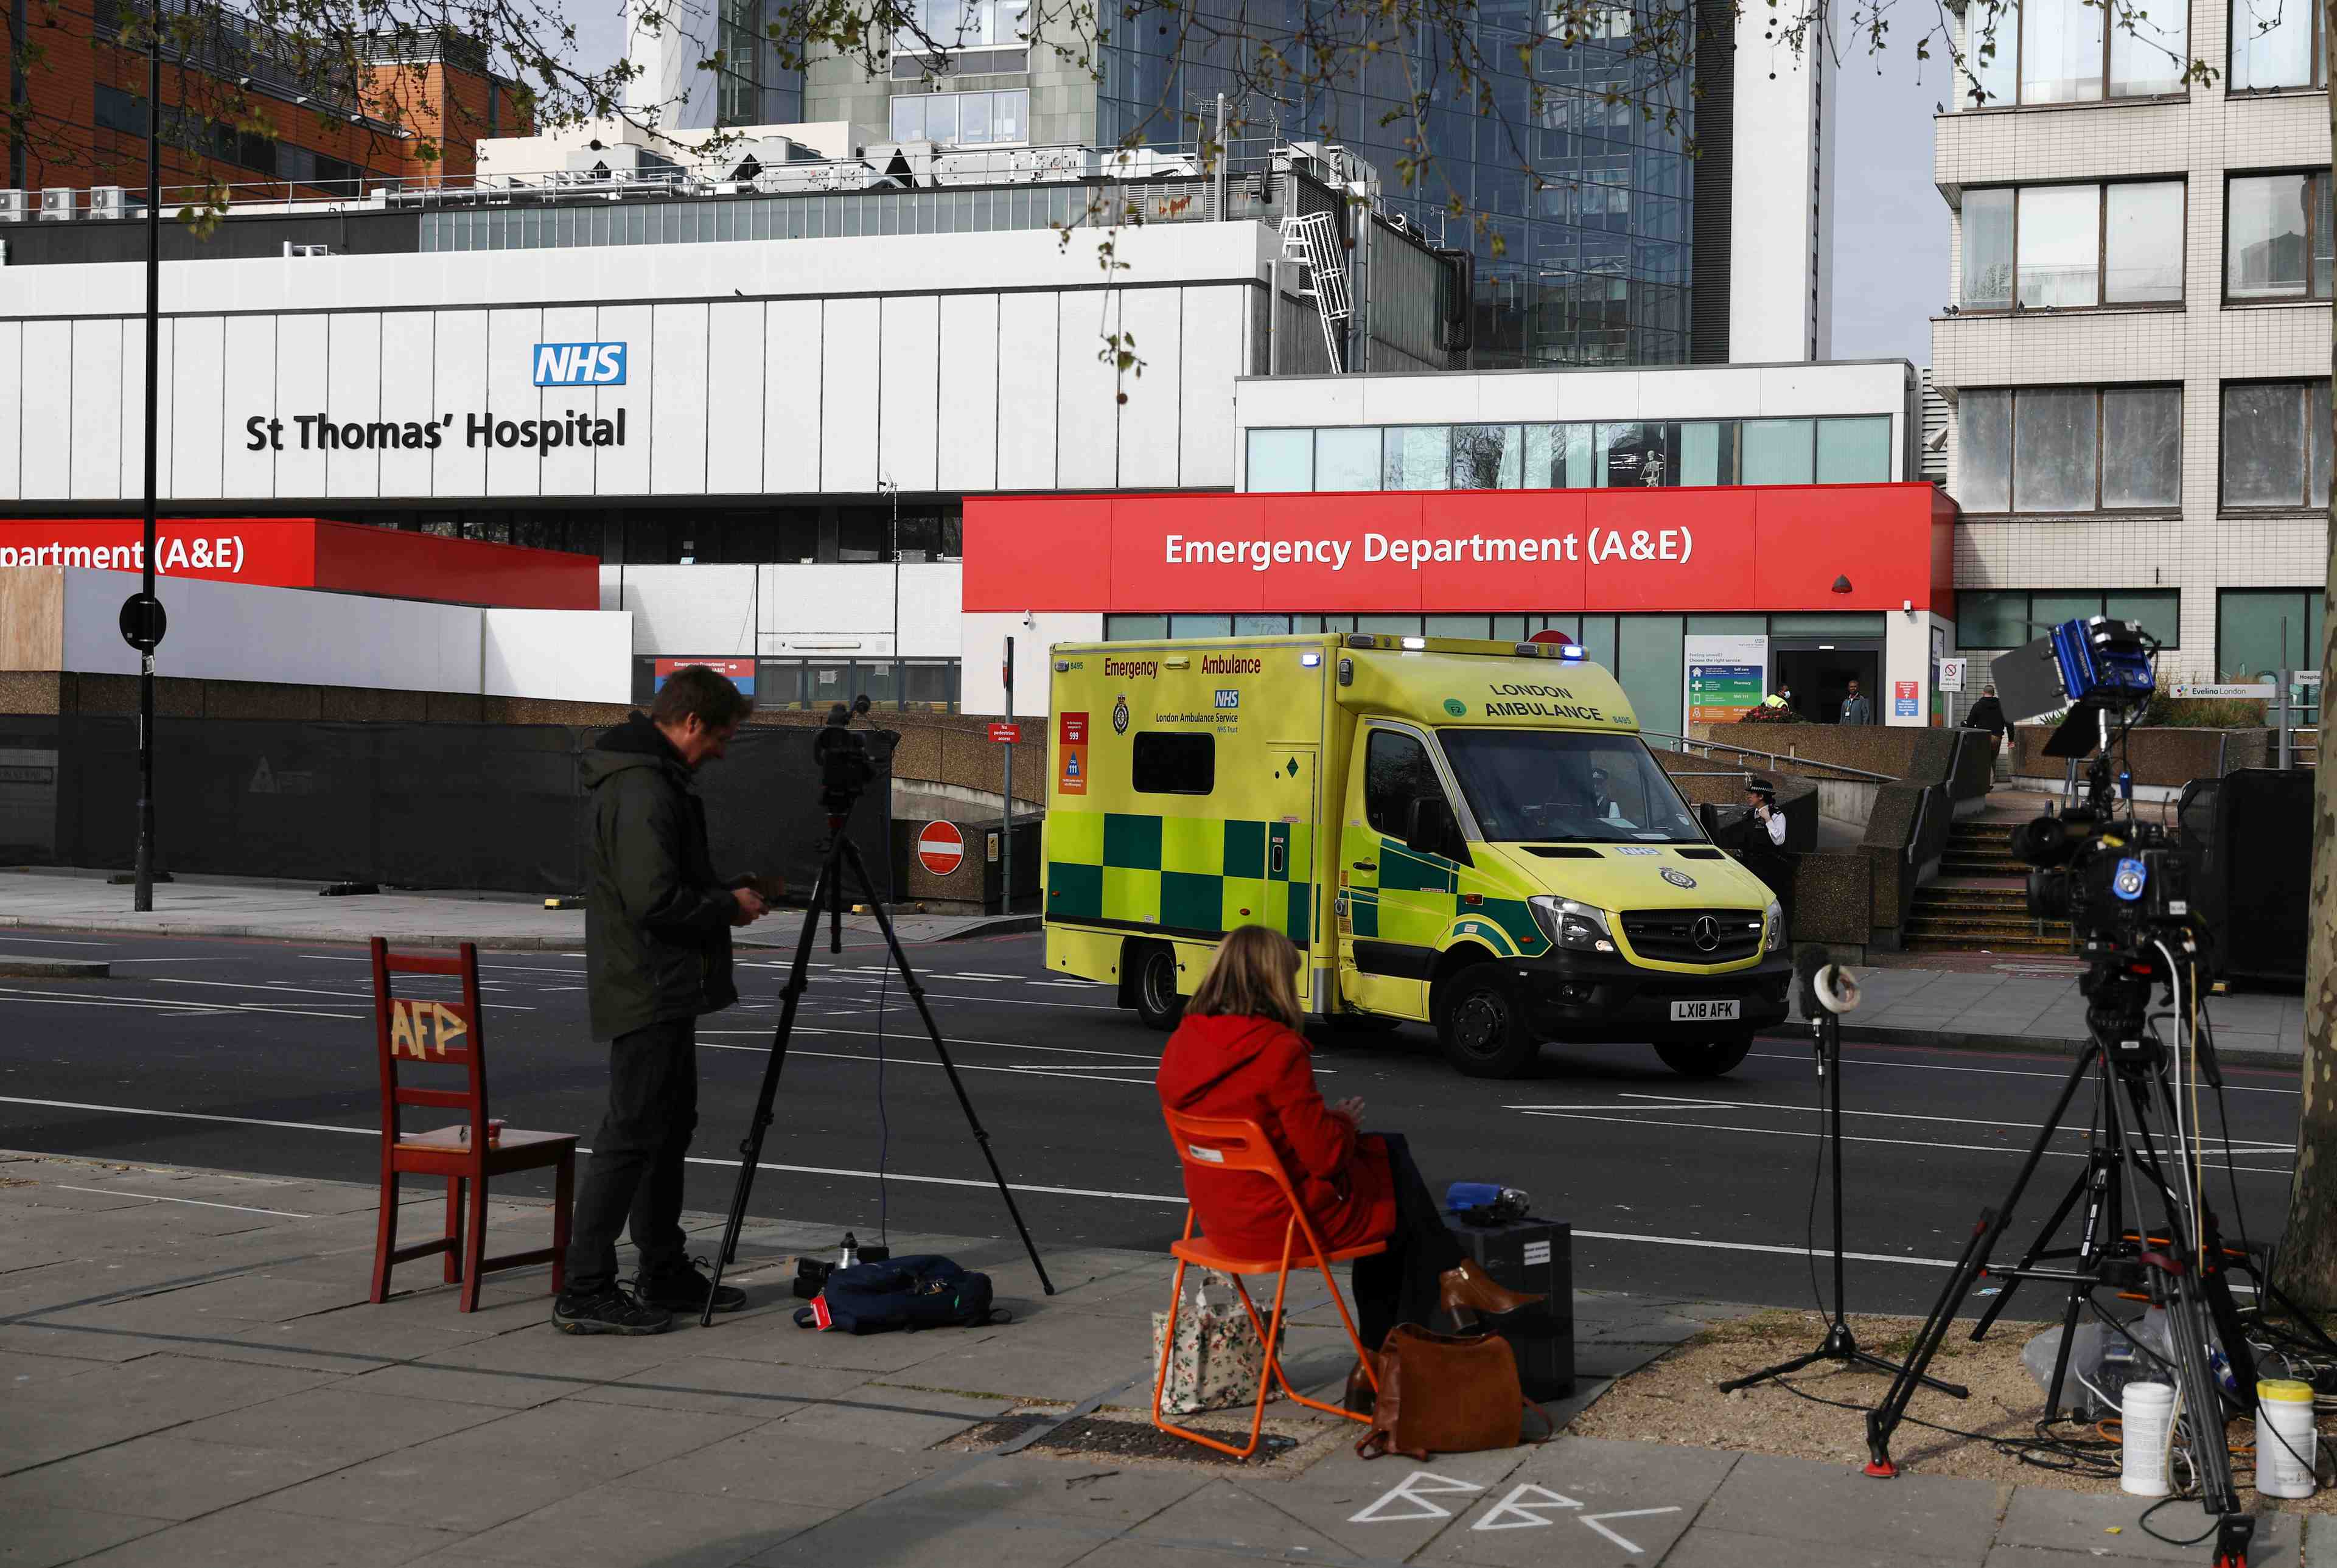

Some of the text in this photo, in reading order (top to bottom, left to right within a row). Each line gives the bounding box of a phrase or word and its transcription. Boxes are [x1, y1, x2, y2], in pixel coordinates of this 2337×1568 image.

[534, 344, 622, 382] NHS
[246, 408, 626, 456] St Thomas' Hospital
[155, 535, 245, 574] (A&E)
[1165, 526, 1694, 571] Emergency Department (A&E)
[1105, 654, 1261, 679] Emergency Ambulance
[1217, 691, 1238, 706] NHS
[1489, 684, 1573, 699] LONDON
[1156, 713, 1238, 722] London Ambulance Service
[1486, 703, 1604, 721] AMBULANCE
[1616, 846, 1660, 855] NHS
[1679, 1002, 1733, 1018] LX18 AFK
[391, 1000, 468, 1059] AFP
